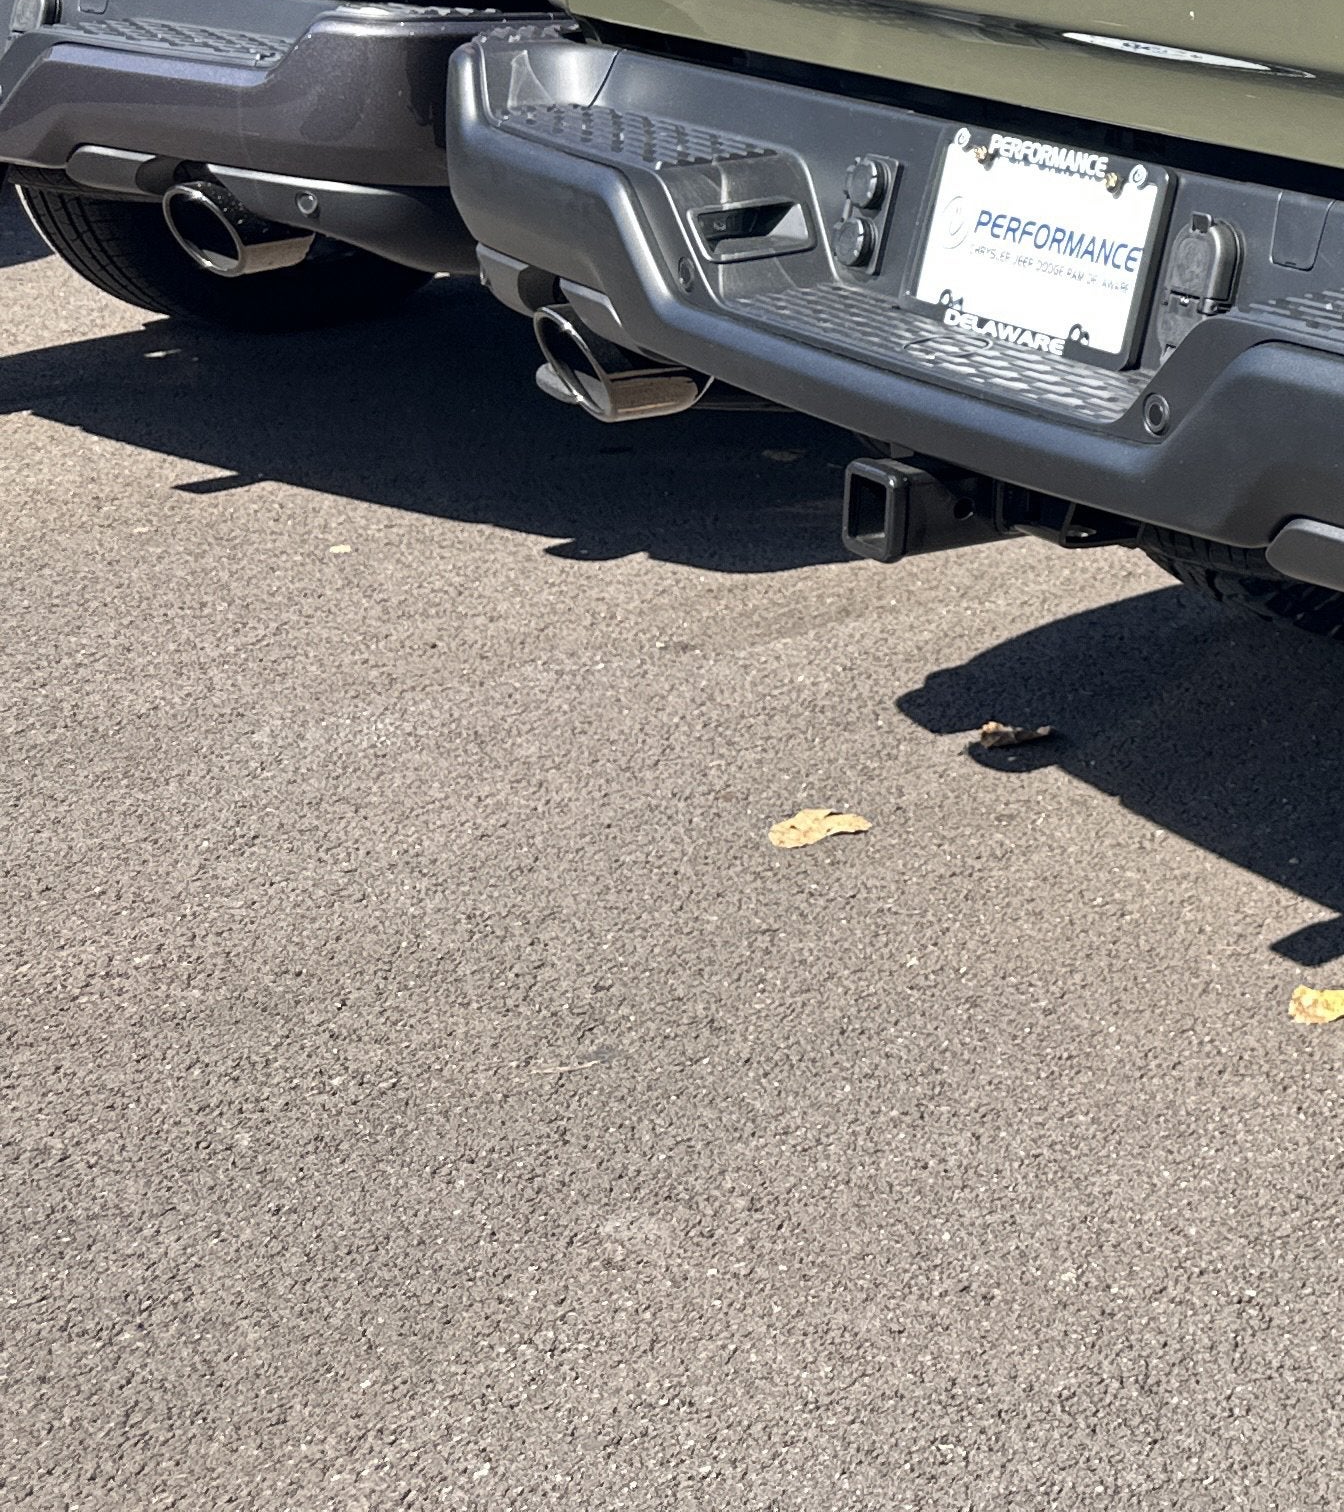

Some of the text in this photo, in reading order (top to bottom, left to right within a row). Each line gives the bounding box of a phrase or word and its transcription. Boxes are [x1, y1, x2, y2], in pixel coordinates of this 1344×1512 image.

[988, 133, 1109, 178] PERFORMANCE
[974, 209, 1144, 273] PERFORMANCE
[943, 308, 1066, 356] DELAWARE
